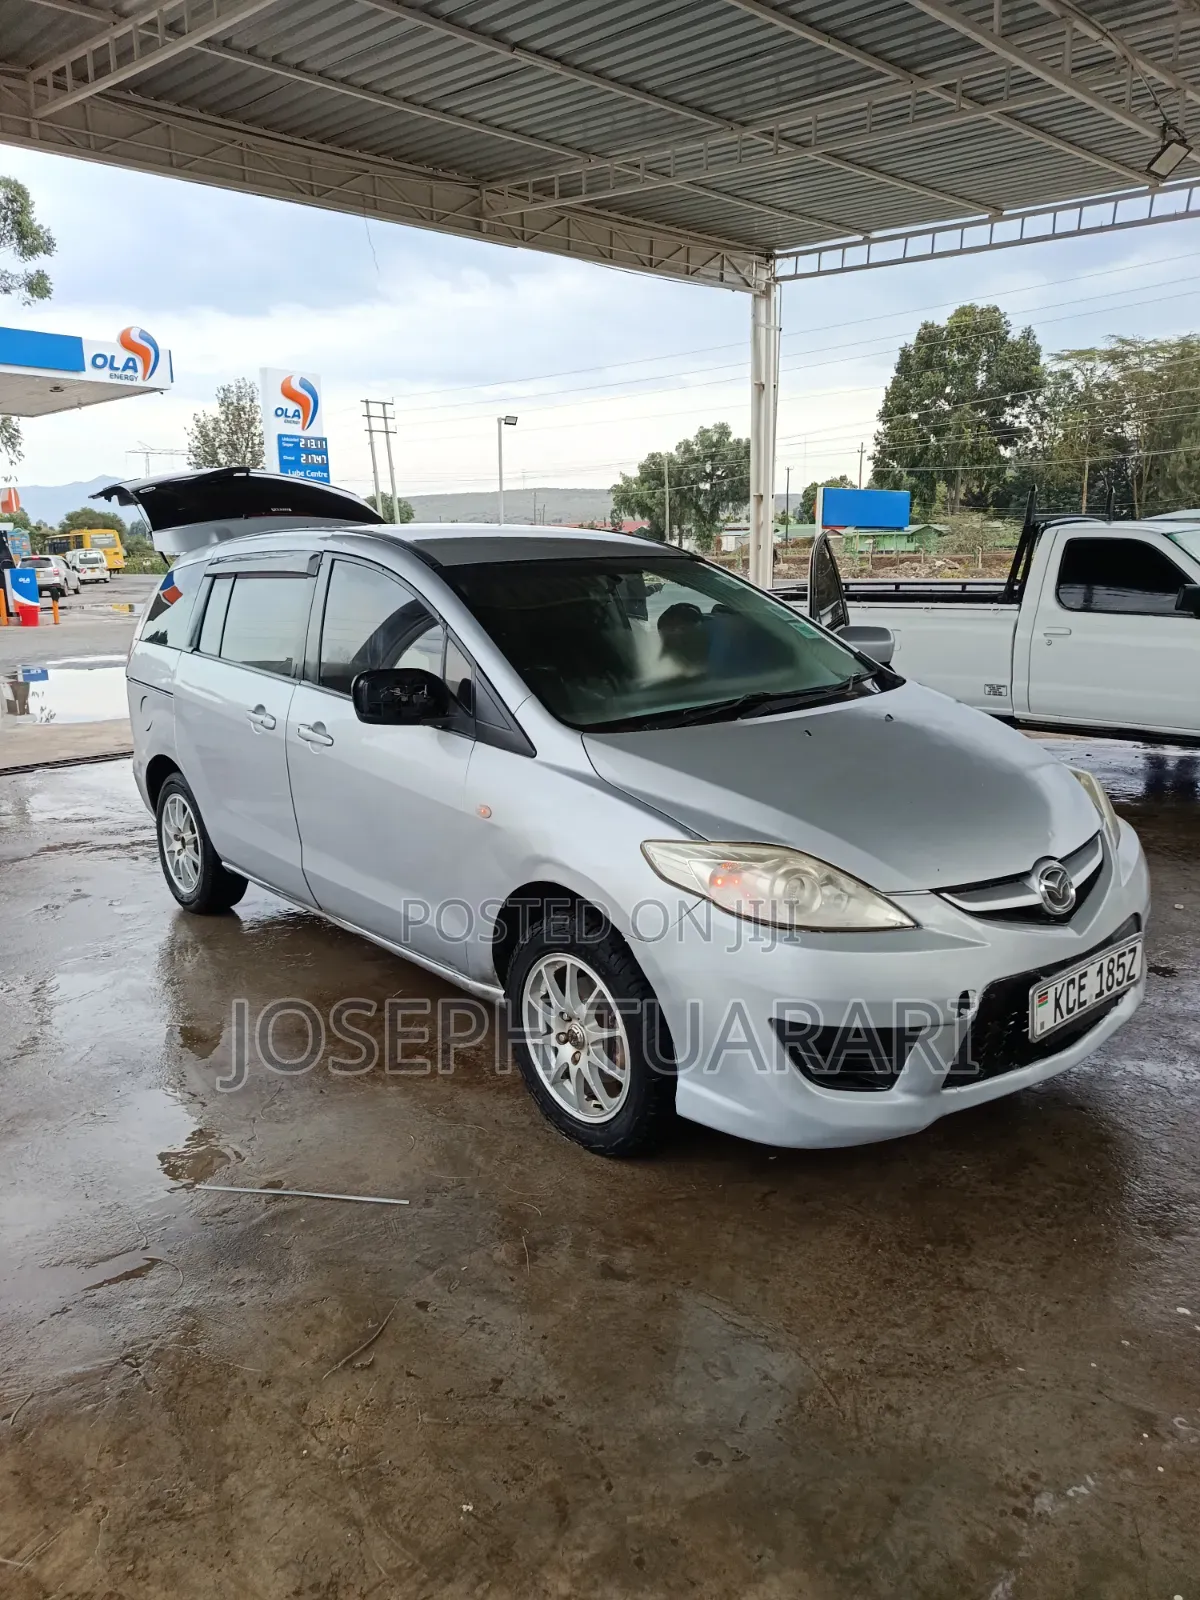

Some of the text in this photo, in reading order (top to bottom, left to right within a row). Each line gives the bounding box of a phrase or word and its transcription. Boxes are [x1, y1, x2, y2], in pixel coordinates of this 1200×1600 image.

[91, 353, 138, 372] OLA
[109, 373, 139, 381] ENERGY
[274, 407, 301, 419] OLA
[288, 469, 328, 478] Lube Centre
[1054, 946, 1137, 1024] KCE 185Z
